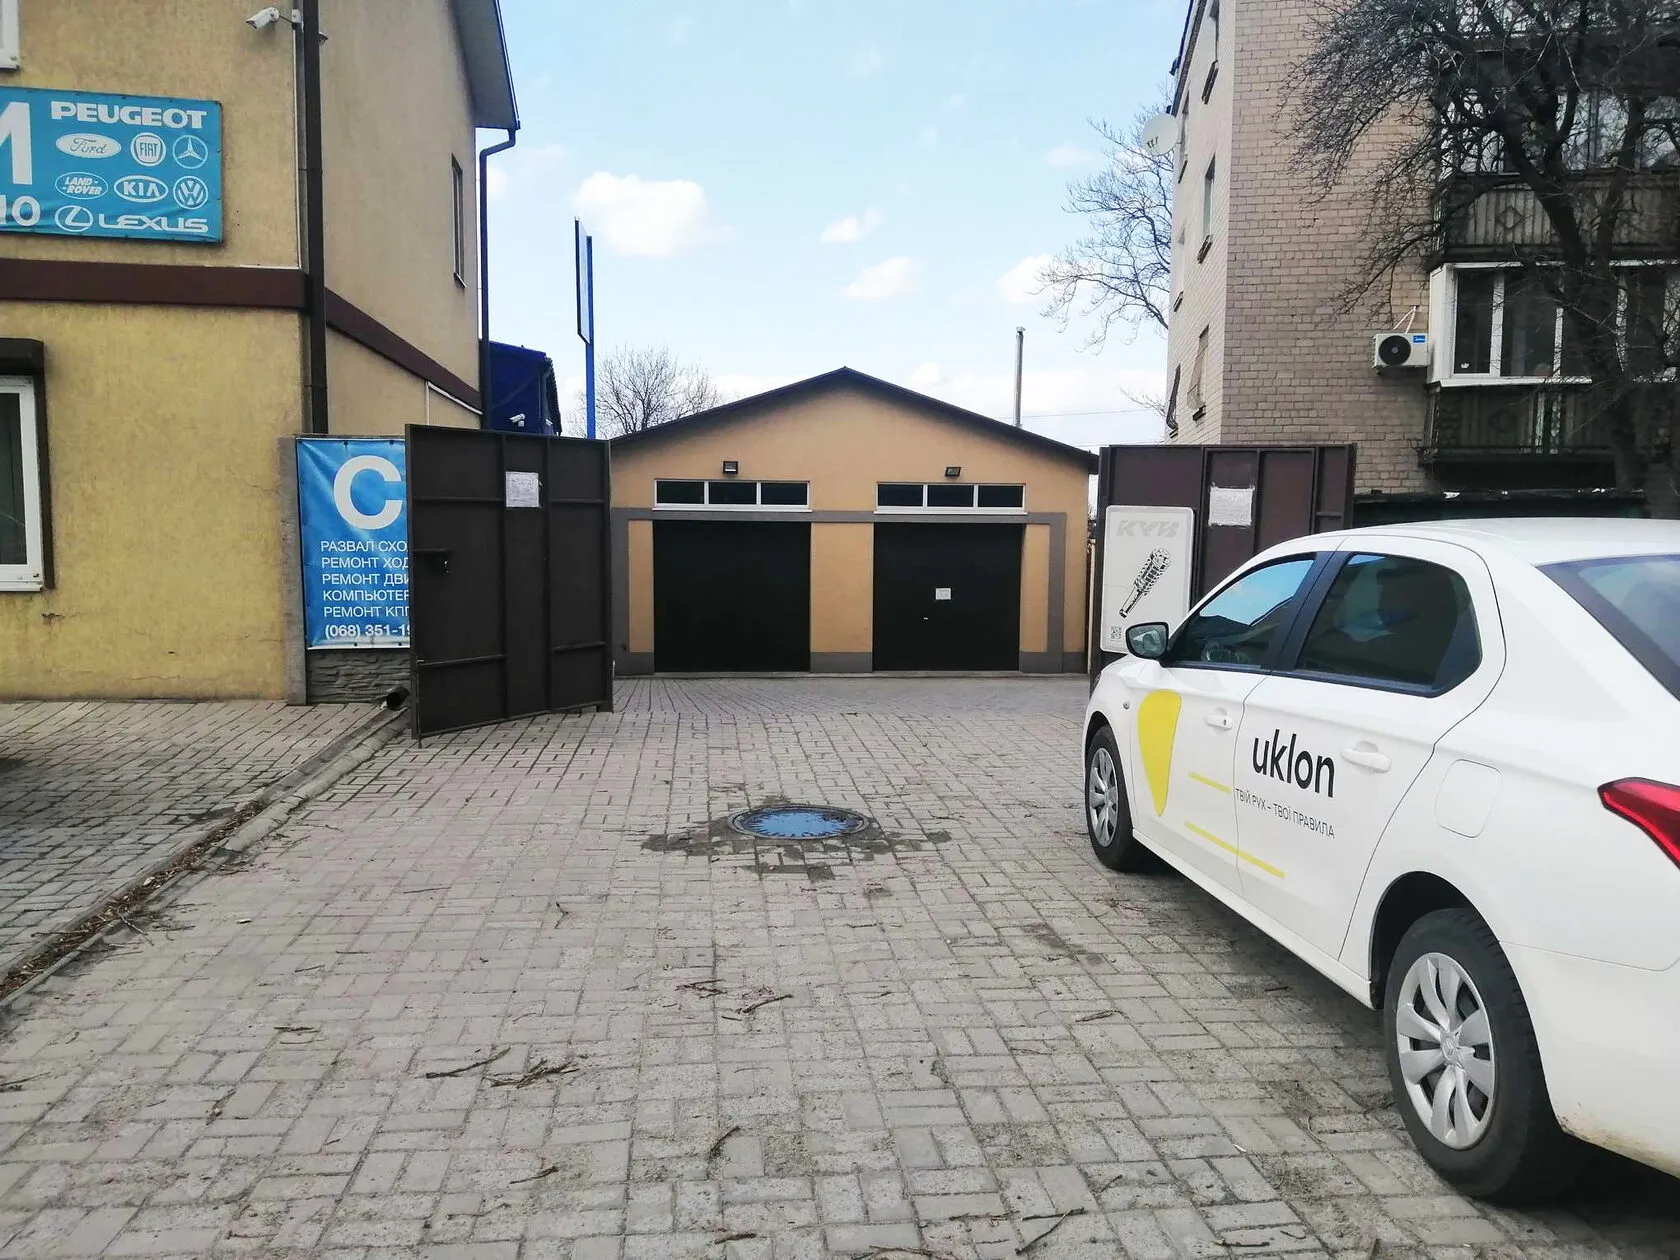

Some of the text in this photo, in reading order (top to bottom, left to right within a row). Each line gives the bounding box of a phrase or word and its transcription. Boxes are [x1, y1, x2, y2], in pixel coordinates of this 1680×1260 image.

[51, 101, 207, 129] PEUGEOT
[70, 137, 107, 155] Ford
[140, 143, 158, 158] FIAT
[123, 181, 160, 197] KIA
[99, 213, 208, 233] LEXUS
[320, 540, 408, 552] РАЗВАЛ СХО
[321, 557, 380, 568] РЕМОНТ
[322, 573, 380, 585] РЕМОНТ
[323, 606, 382, 618] РЕМОНТ
[325, 624, 361, 640] (068)
[1252, 729, 1335, 798] uklon
[1235, 788, 1252, 805] ТВІЙ
[1252, 794, 1267, 811] РУХ
[1273, 802, 1292, 821] ТВОЇ
[1293, 810, 1336, 839] ПРАВИЛА
